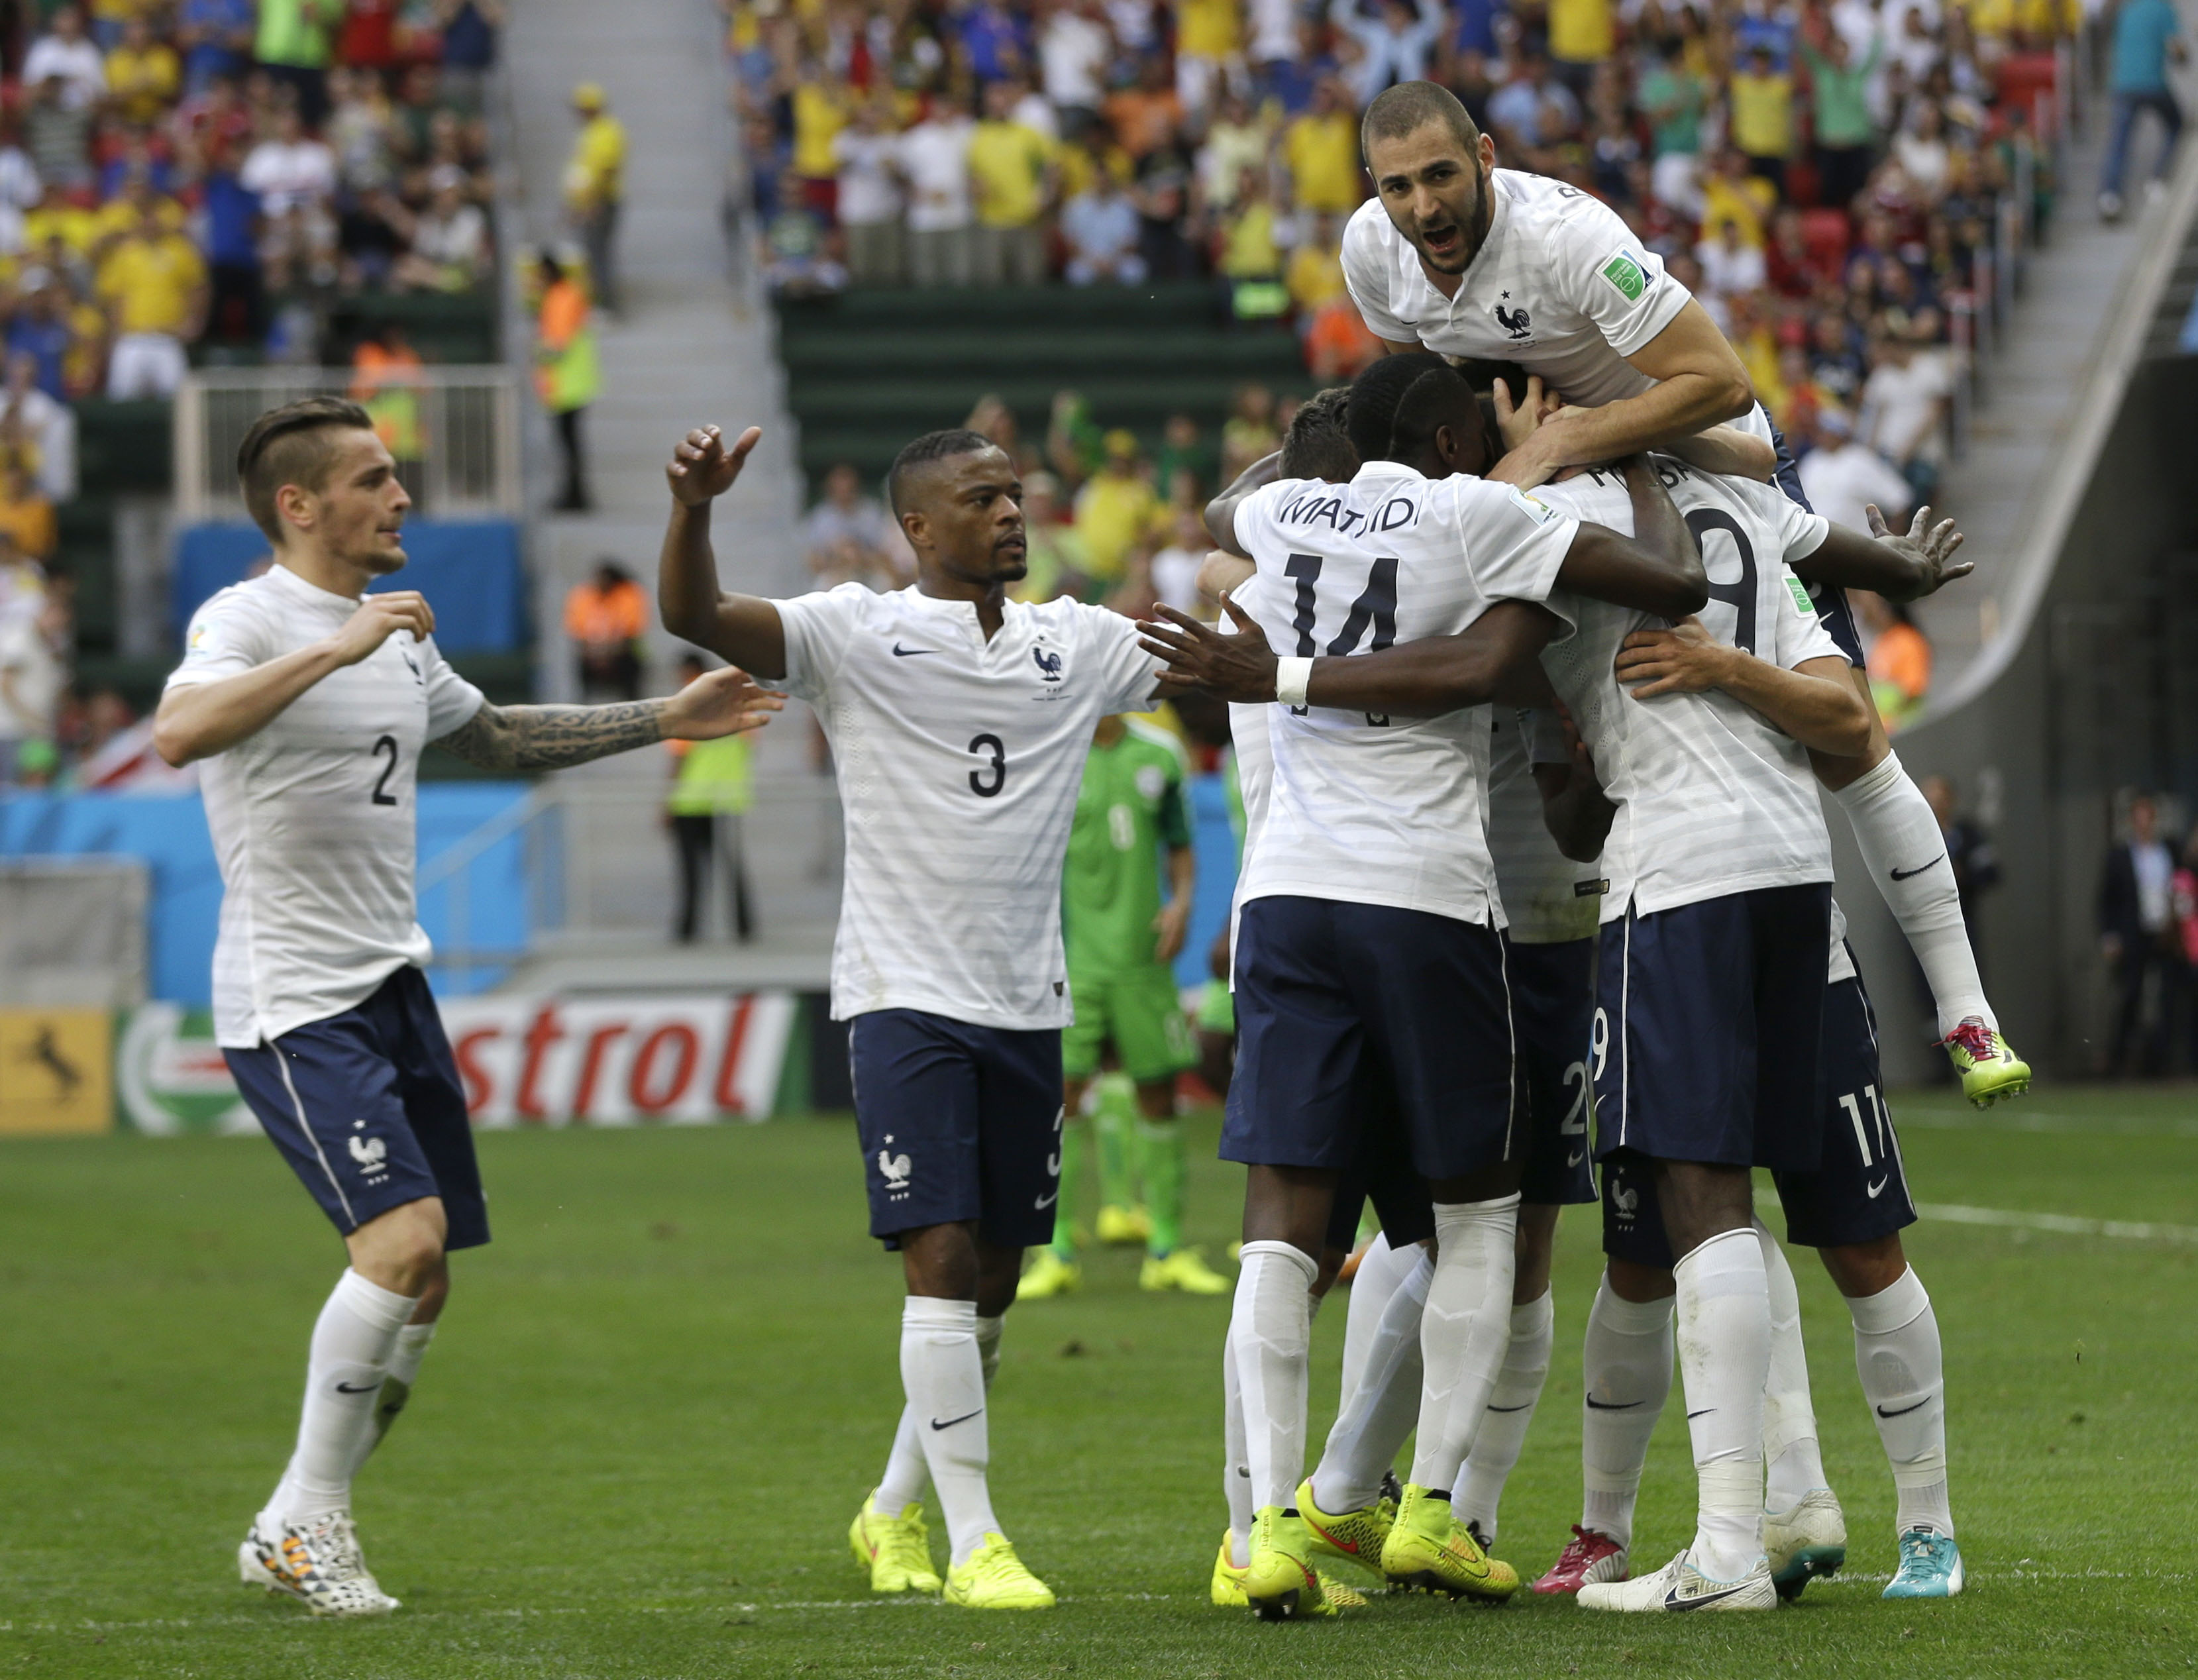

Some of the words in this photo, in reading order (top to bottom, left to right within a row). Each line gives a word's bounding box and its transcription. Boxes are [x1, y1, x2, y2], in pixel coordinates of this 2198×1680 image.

[371, 735, 398, 806] 2
[968, 733, 1006, 798] 3
[454, 991, 760, 1120] strol
[1838, 1084, 1885, 1167] 11
